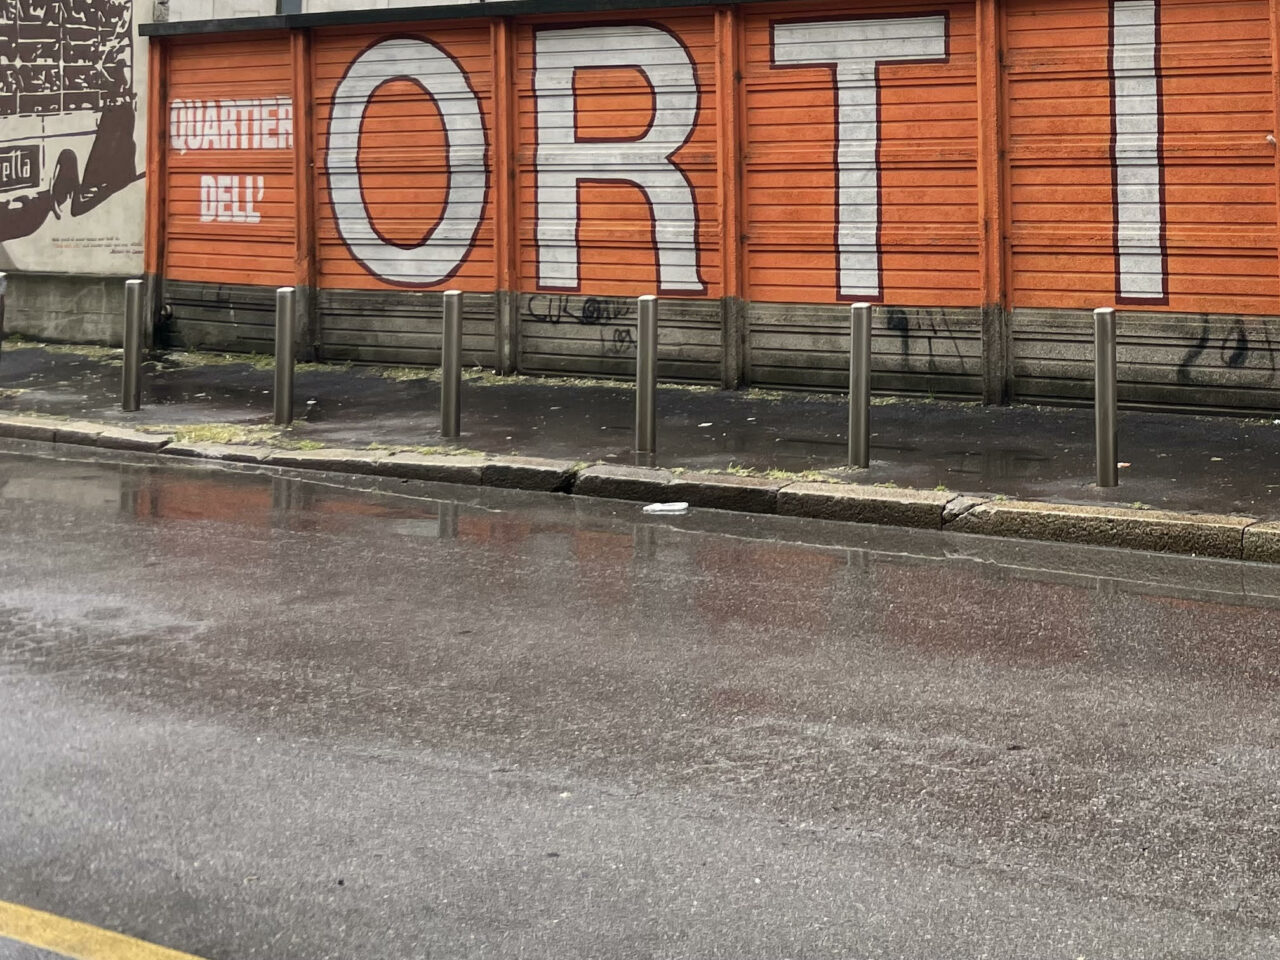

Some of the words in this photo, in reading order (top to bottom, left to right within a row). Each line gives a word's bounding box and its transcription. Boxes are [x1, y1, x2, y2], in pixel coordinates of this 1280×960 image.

[170, 96, 294, 155] QUARTIER
[0, 149, 31, 182] etta
[200, 175, 265, 224] DELL'
